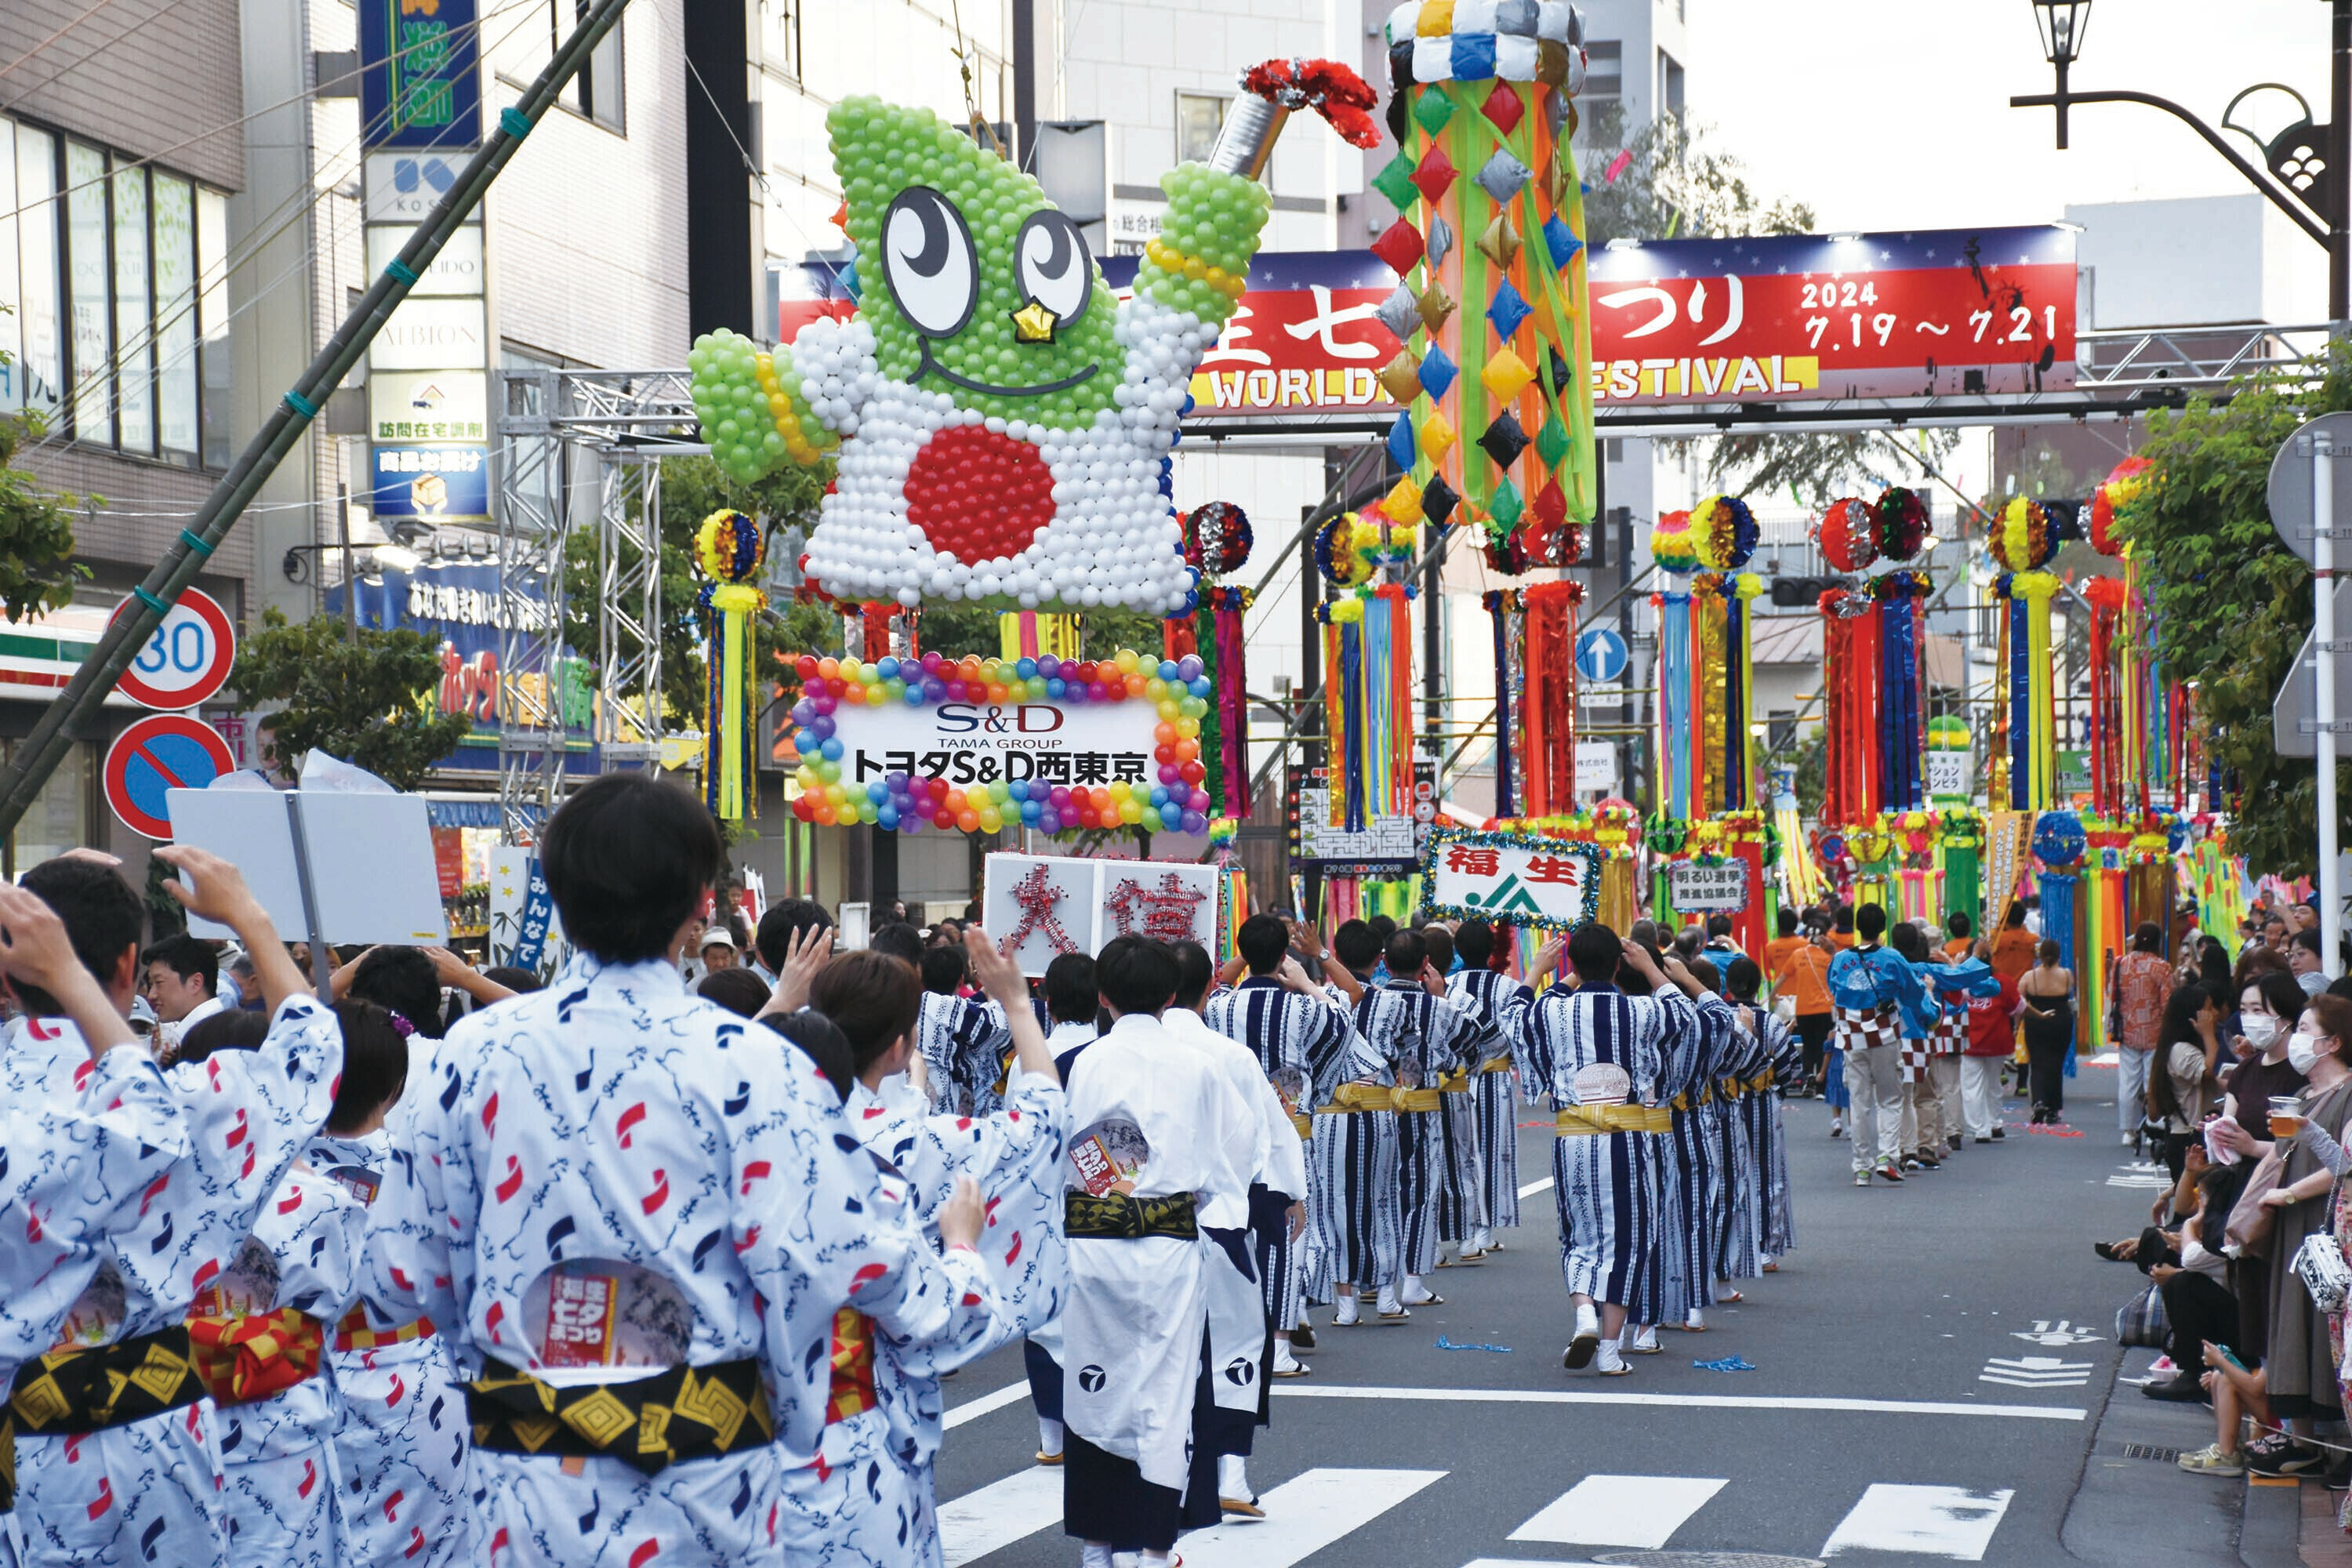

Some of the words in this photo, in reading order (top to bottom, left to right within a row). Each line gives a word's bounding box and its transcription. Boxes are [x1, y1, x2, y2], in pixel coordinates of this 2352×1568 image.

[397, 200, 436, 212] KOS
[1801, 281, 1878, 308] 2024
[379, 325, 477, 346] ALBION
[1806, 313, 1896, 350] 7.19
[1969, 305, 2056, 345] 7.21
[1209, 367, 1394, 408] WORLD
[1592, 355, 1800, 399] ESTIVAL
[378, 422, 483, 438] 訪問在宅調剤
[379, 451, 482, 473] 商品お届け
[135, 621, 204, 673] 30
[936, 704, 1064, 733] S&D
[938, 739, 990, 749] TAMA
[996, 739, 1062, 749] GROUP
[856, 749, 1148, 785] トヨタS&D西東京
[1446, 844, 1578, 887] 福生
[519, 876, 548, 962] みんなで
[552, 1298, 605, 1326] 七夕
[550, 1323, 603, 1345] まつり
